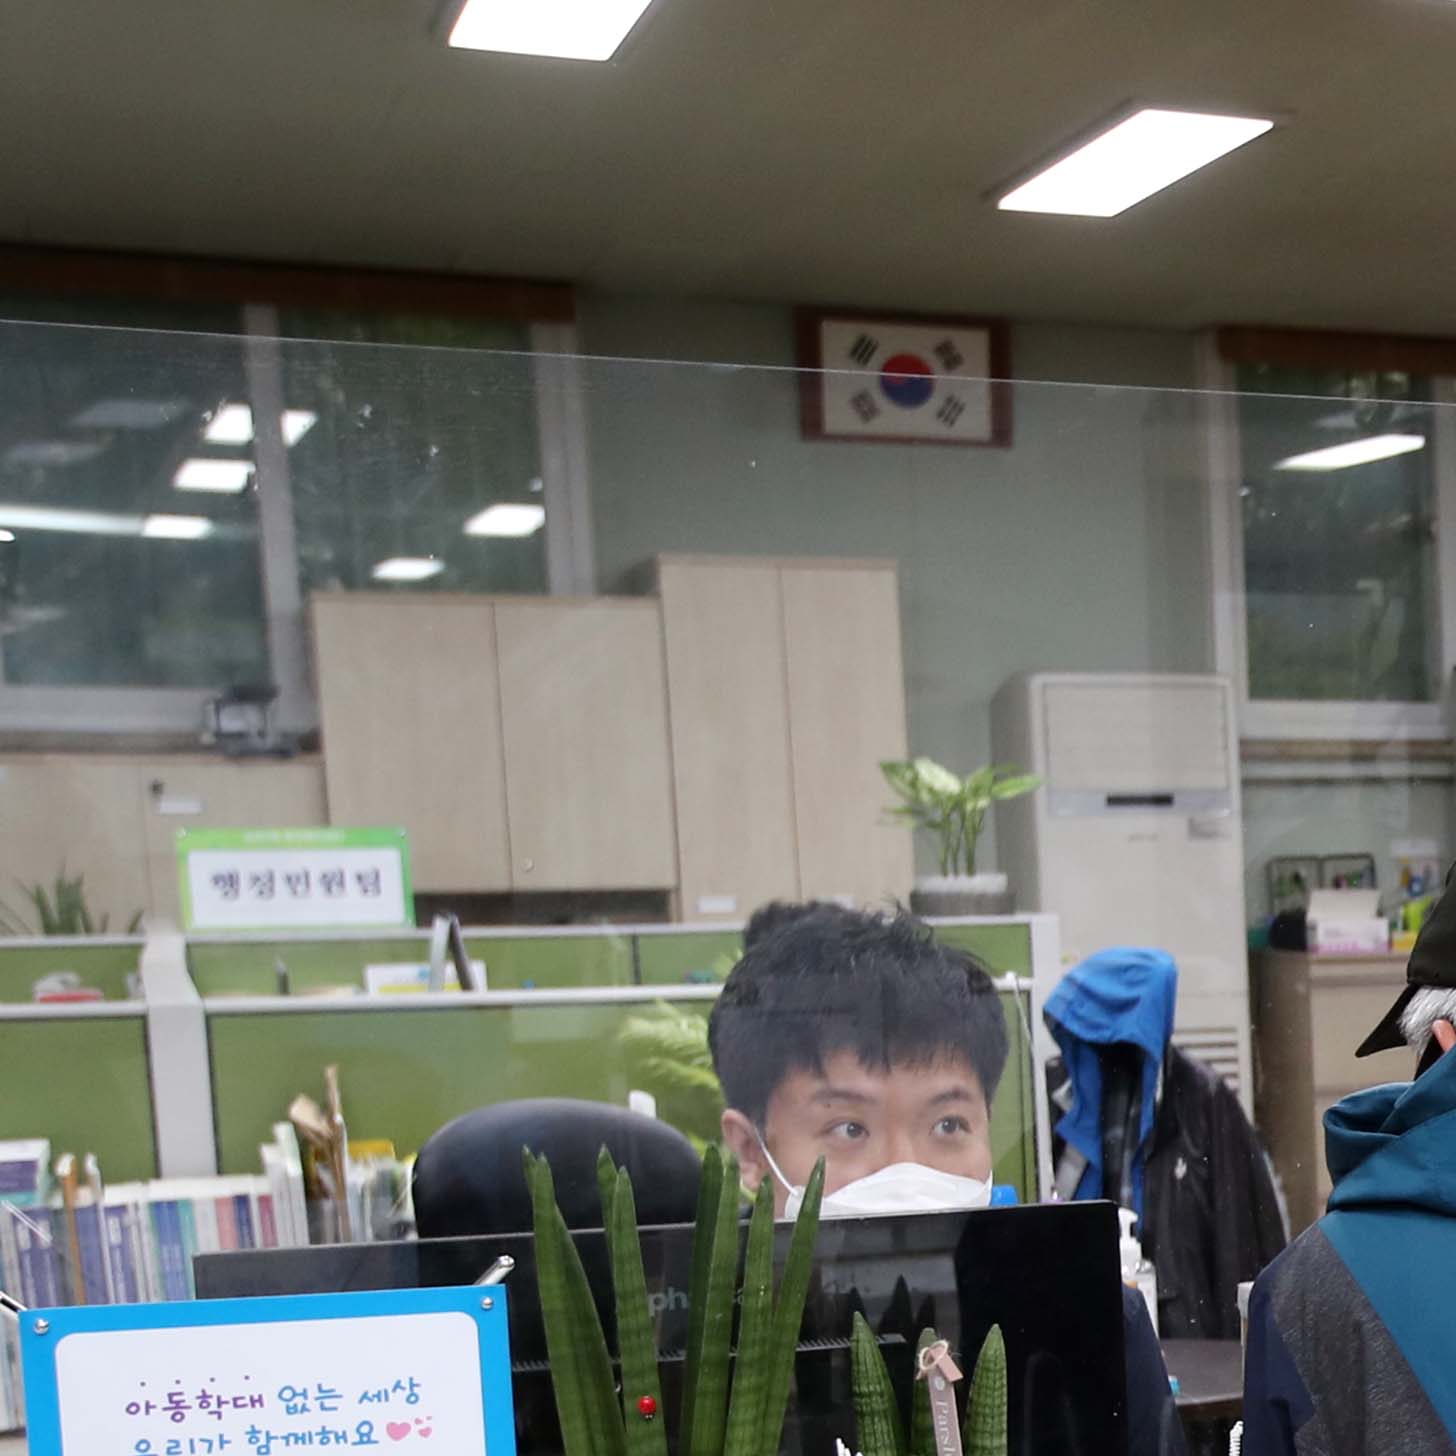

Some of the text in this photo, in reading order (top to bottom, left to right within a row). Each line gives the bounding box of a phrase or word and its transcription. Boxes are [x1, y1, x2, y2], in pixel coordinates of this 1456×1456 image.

[124, 1376, 422, 1425] 아동학대 없는 세상
[243, 1417, 379, 1456] 함께해요
